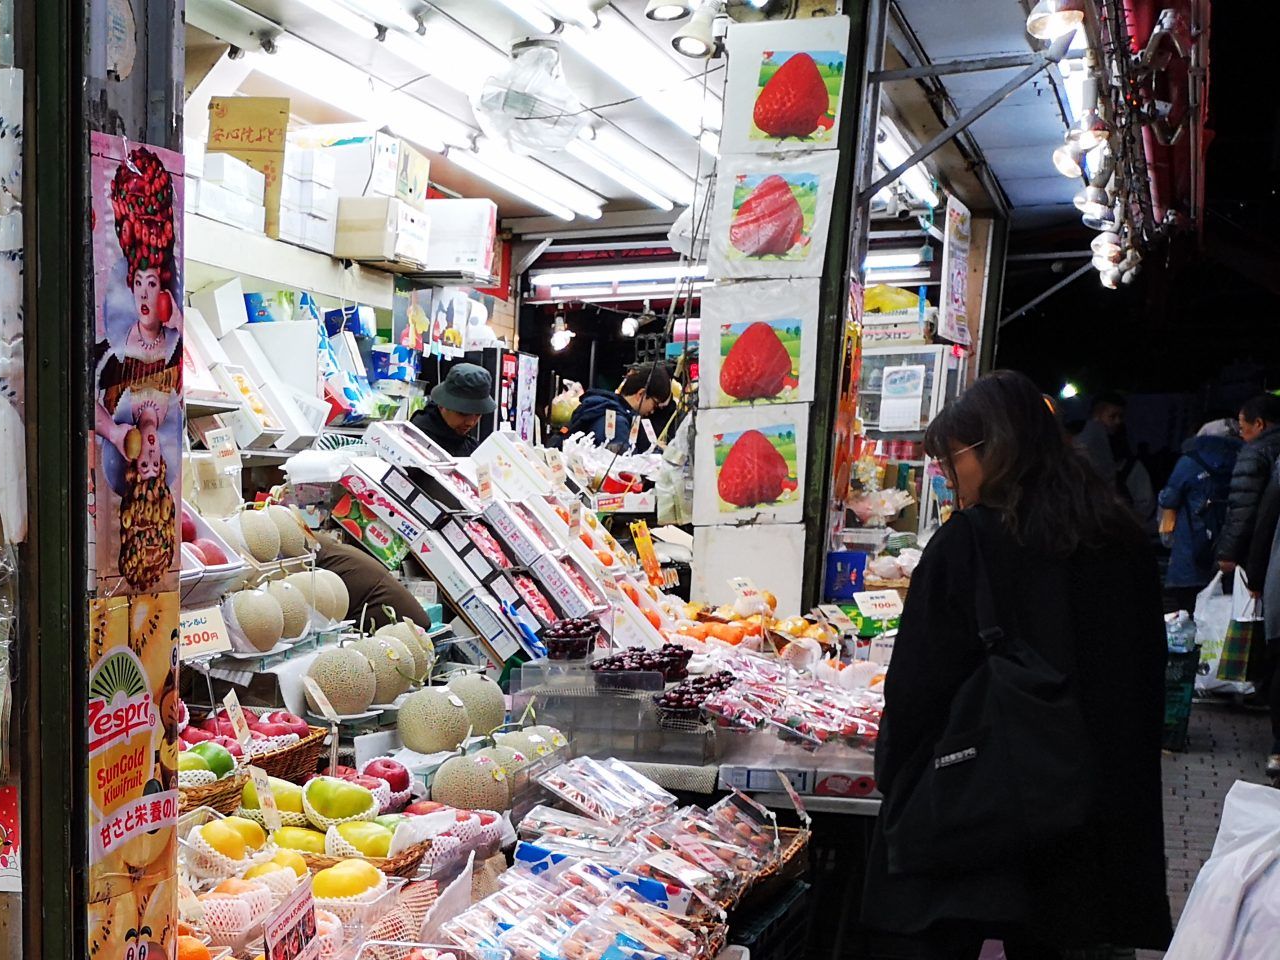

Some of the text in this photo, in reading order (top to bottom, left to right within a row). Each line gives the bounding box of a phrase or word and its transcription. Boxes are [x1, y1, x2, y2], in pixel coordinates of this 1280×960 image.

[88, 694, 152, 751] Zespri
[96, 746, 145, 790] SunGold
[103, 769, 143, 807] Kiwifruit
